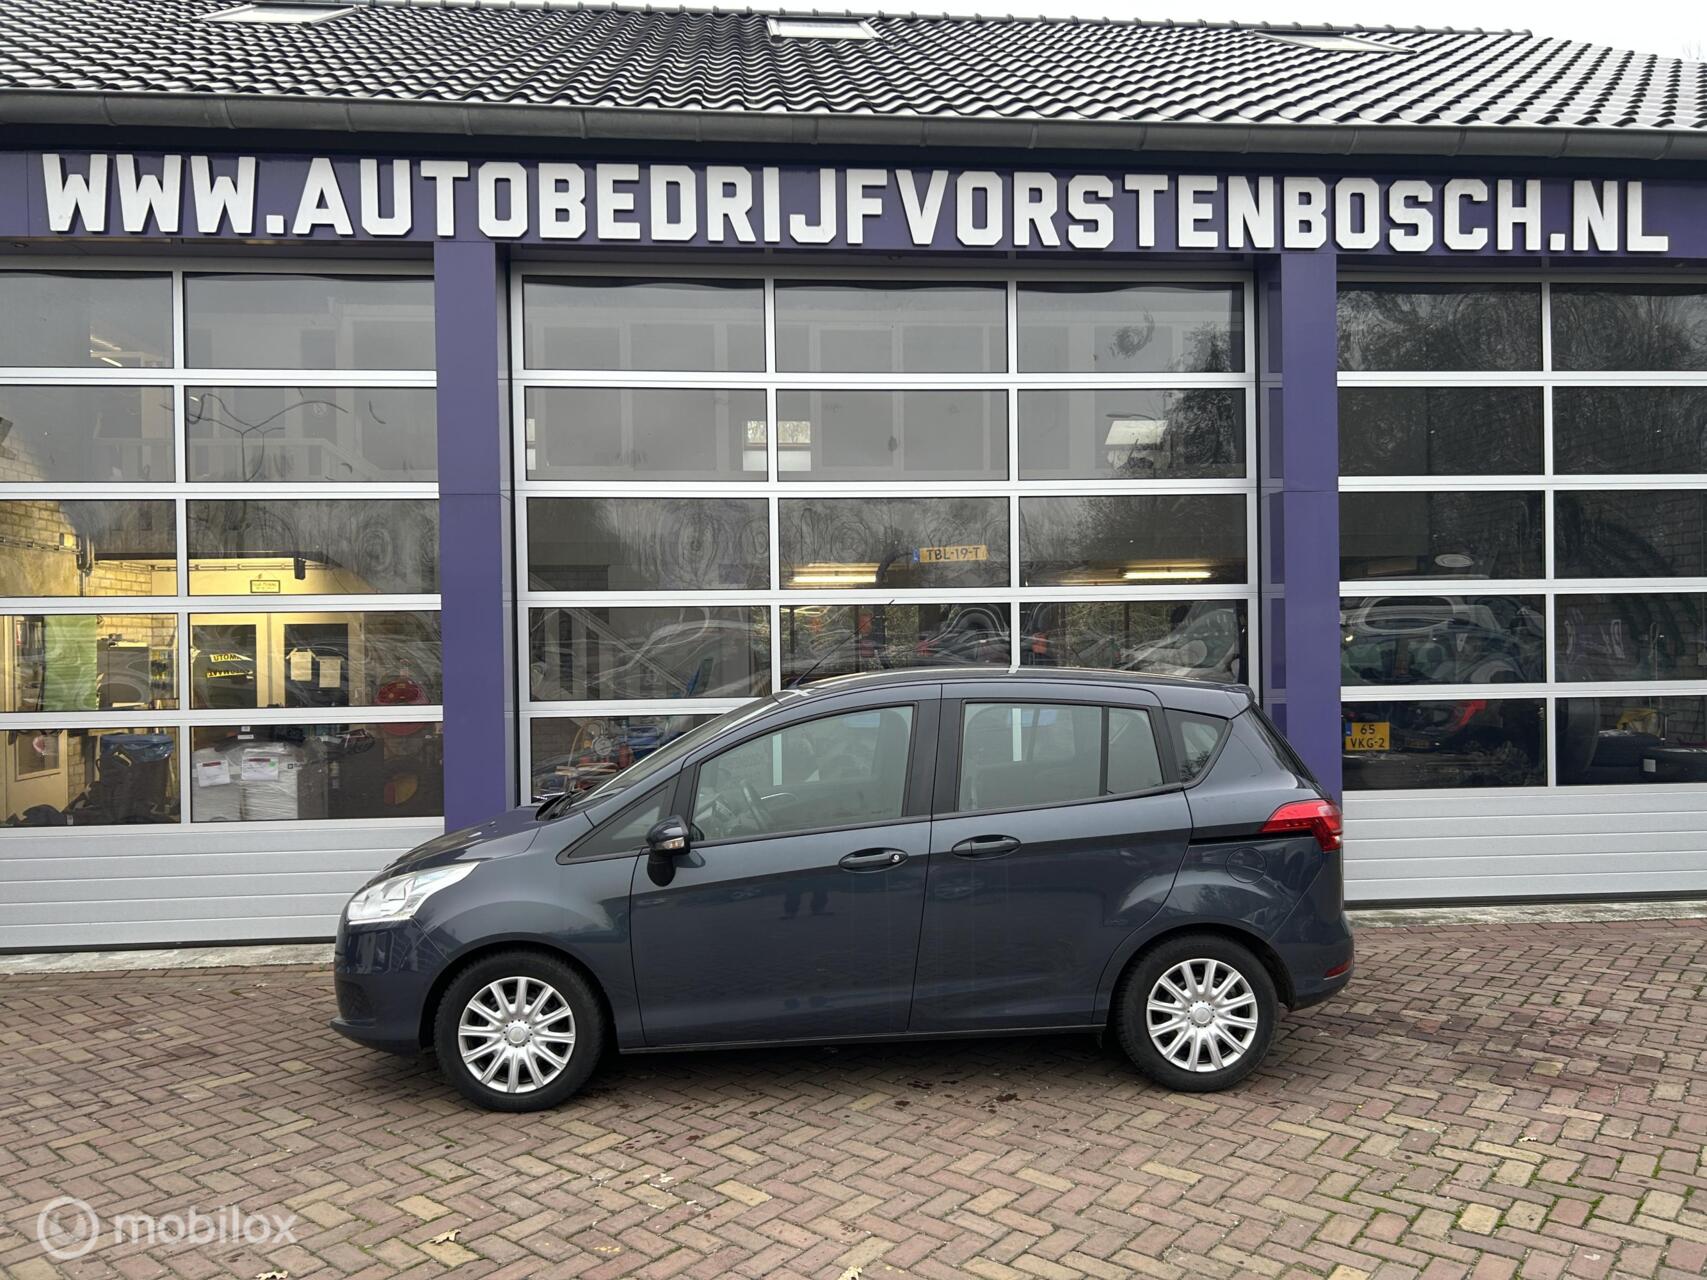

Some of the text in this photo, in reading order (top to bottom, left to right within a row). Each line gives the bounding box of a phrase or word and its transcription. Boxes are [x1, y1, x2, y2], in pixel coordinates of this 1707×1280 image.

[42, 153, 1669, 252] WWW.AUTOBEDRIJFVORSTENBOSCH.NL
[926, 547, 981, 561] TBL-19-T
[1360, 724, 1376, 735] 65
[1350, 737, 1385, 749] VKG-2
